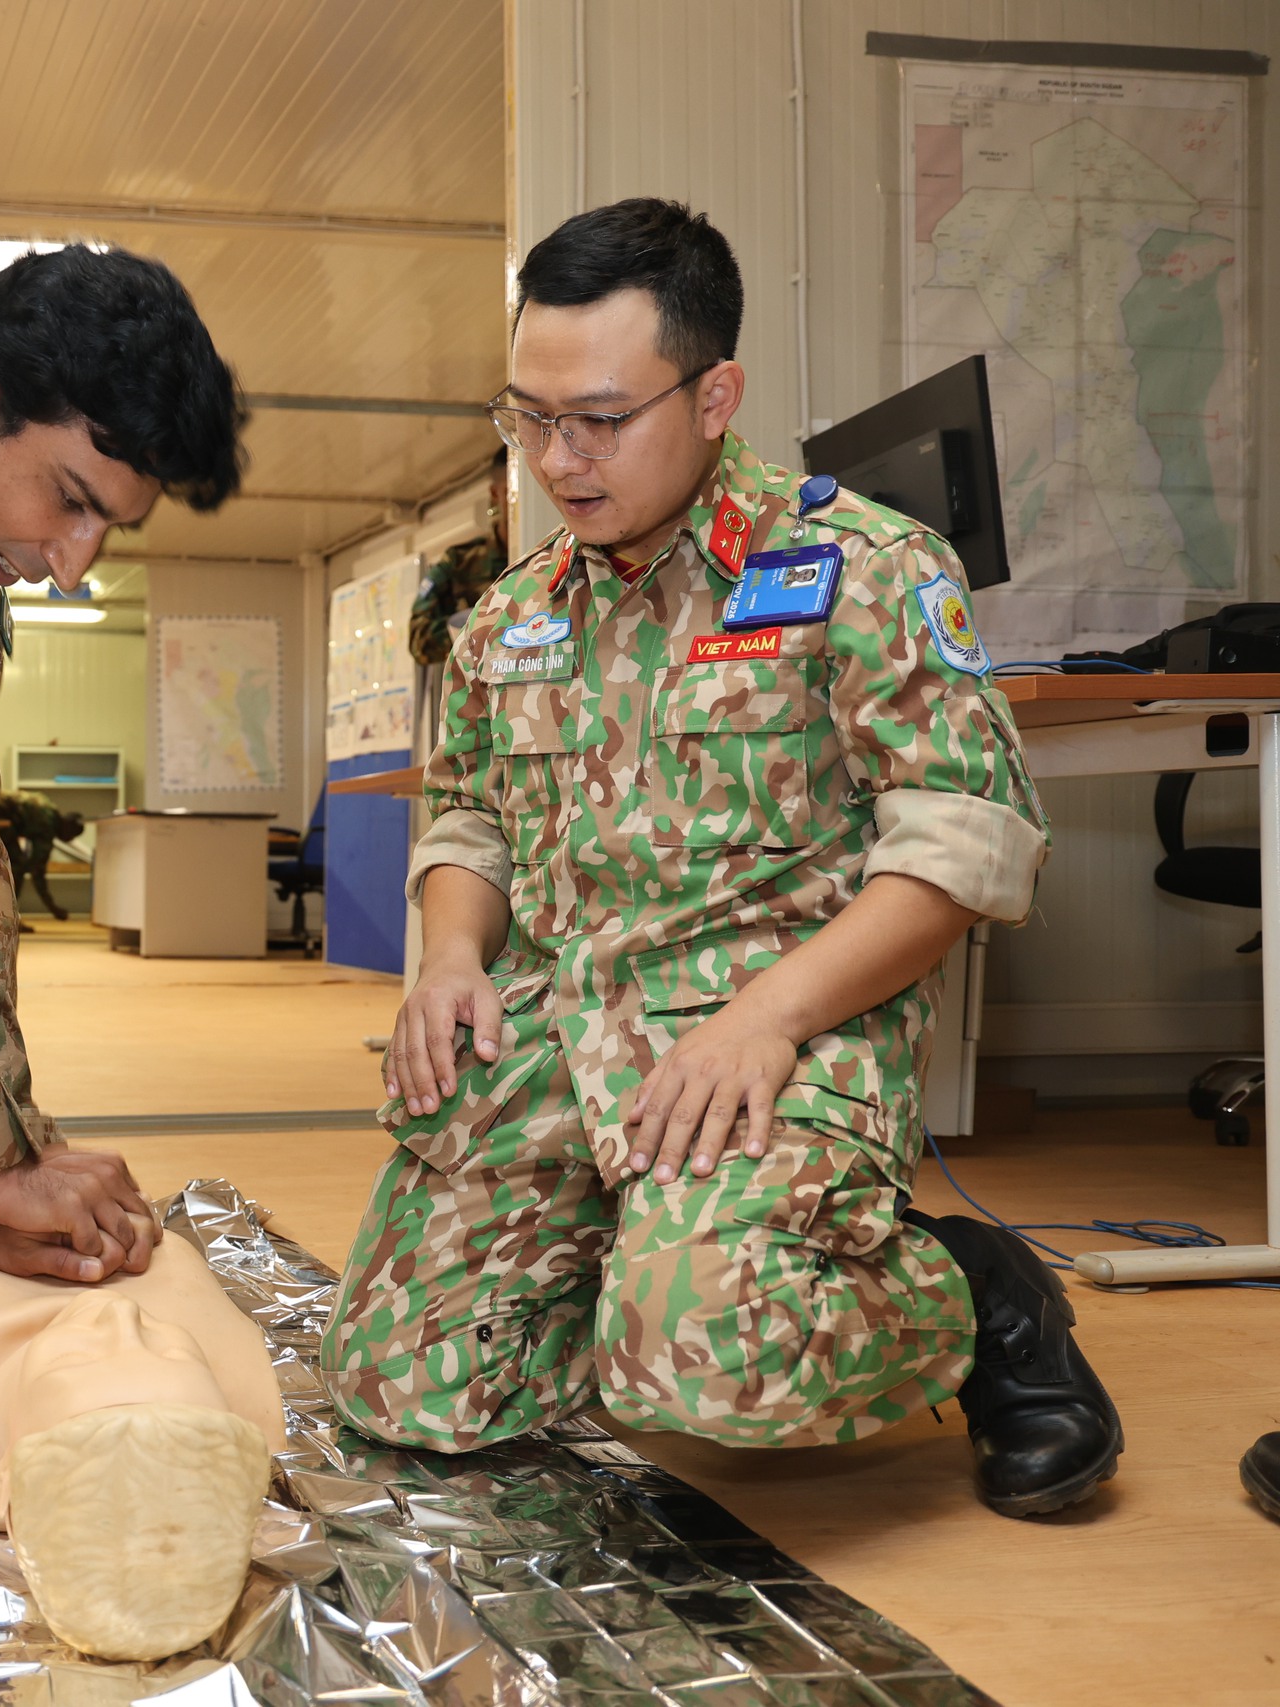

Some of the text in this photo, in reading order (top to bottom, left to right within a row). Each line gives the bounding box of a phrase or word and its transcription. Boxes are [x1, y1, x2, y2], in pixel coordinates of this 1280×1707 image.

[733, 582, 745, 599] NOV
[728, 601, 739, 619] 2026
[697, 635, 777, 656] VIET NAM
[491, 659, 517, 676] PHẠM
[518, 655, 543, 672] CÔNG
